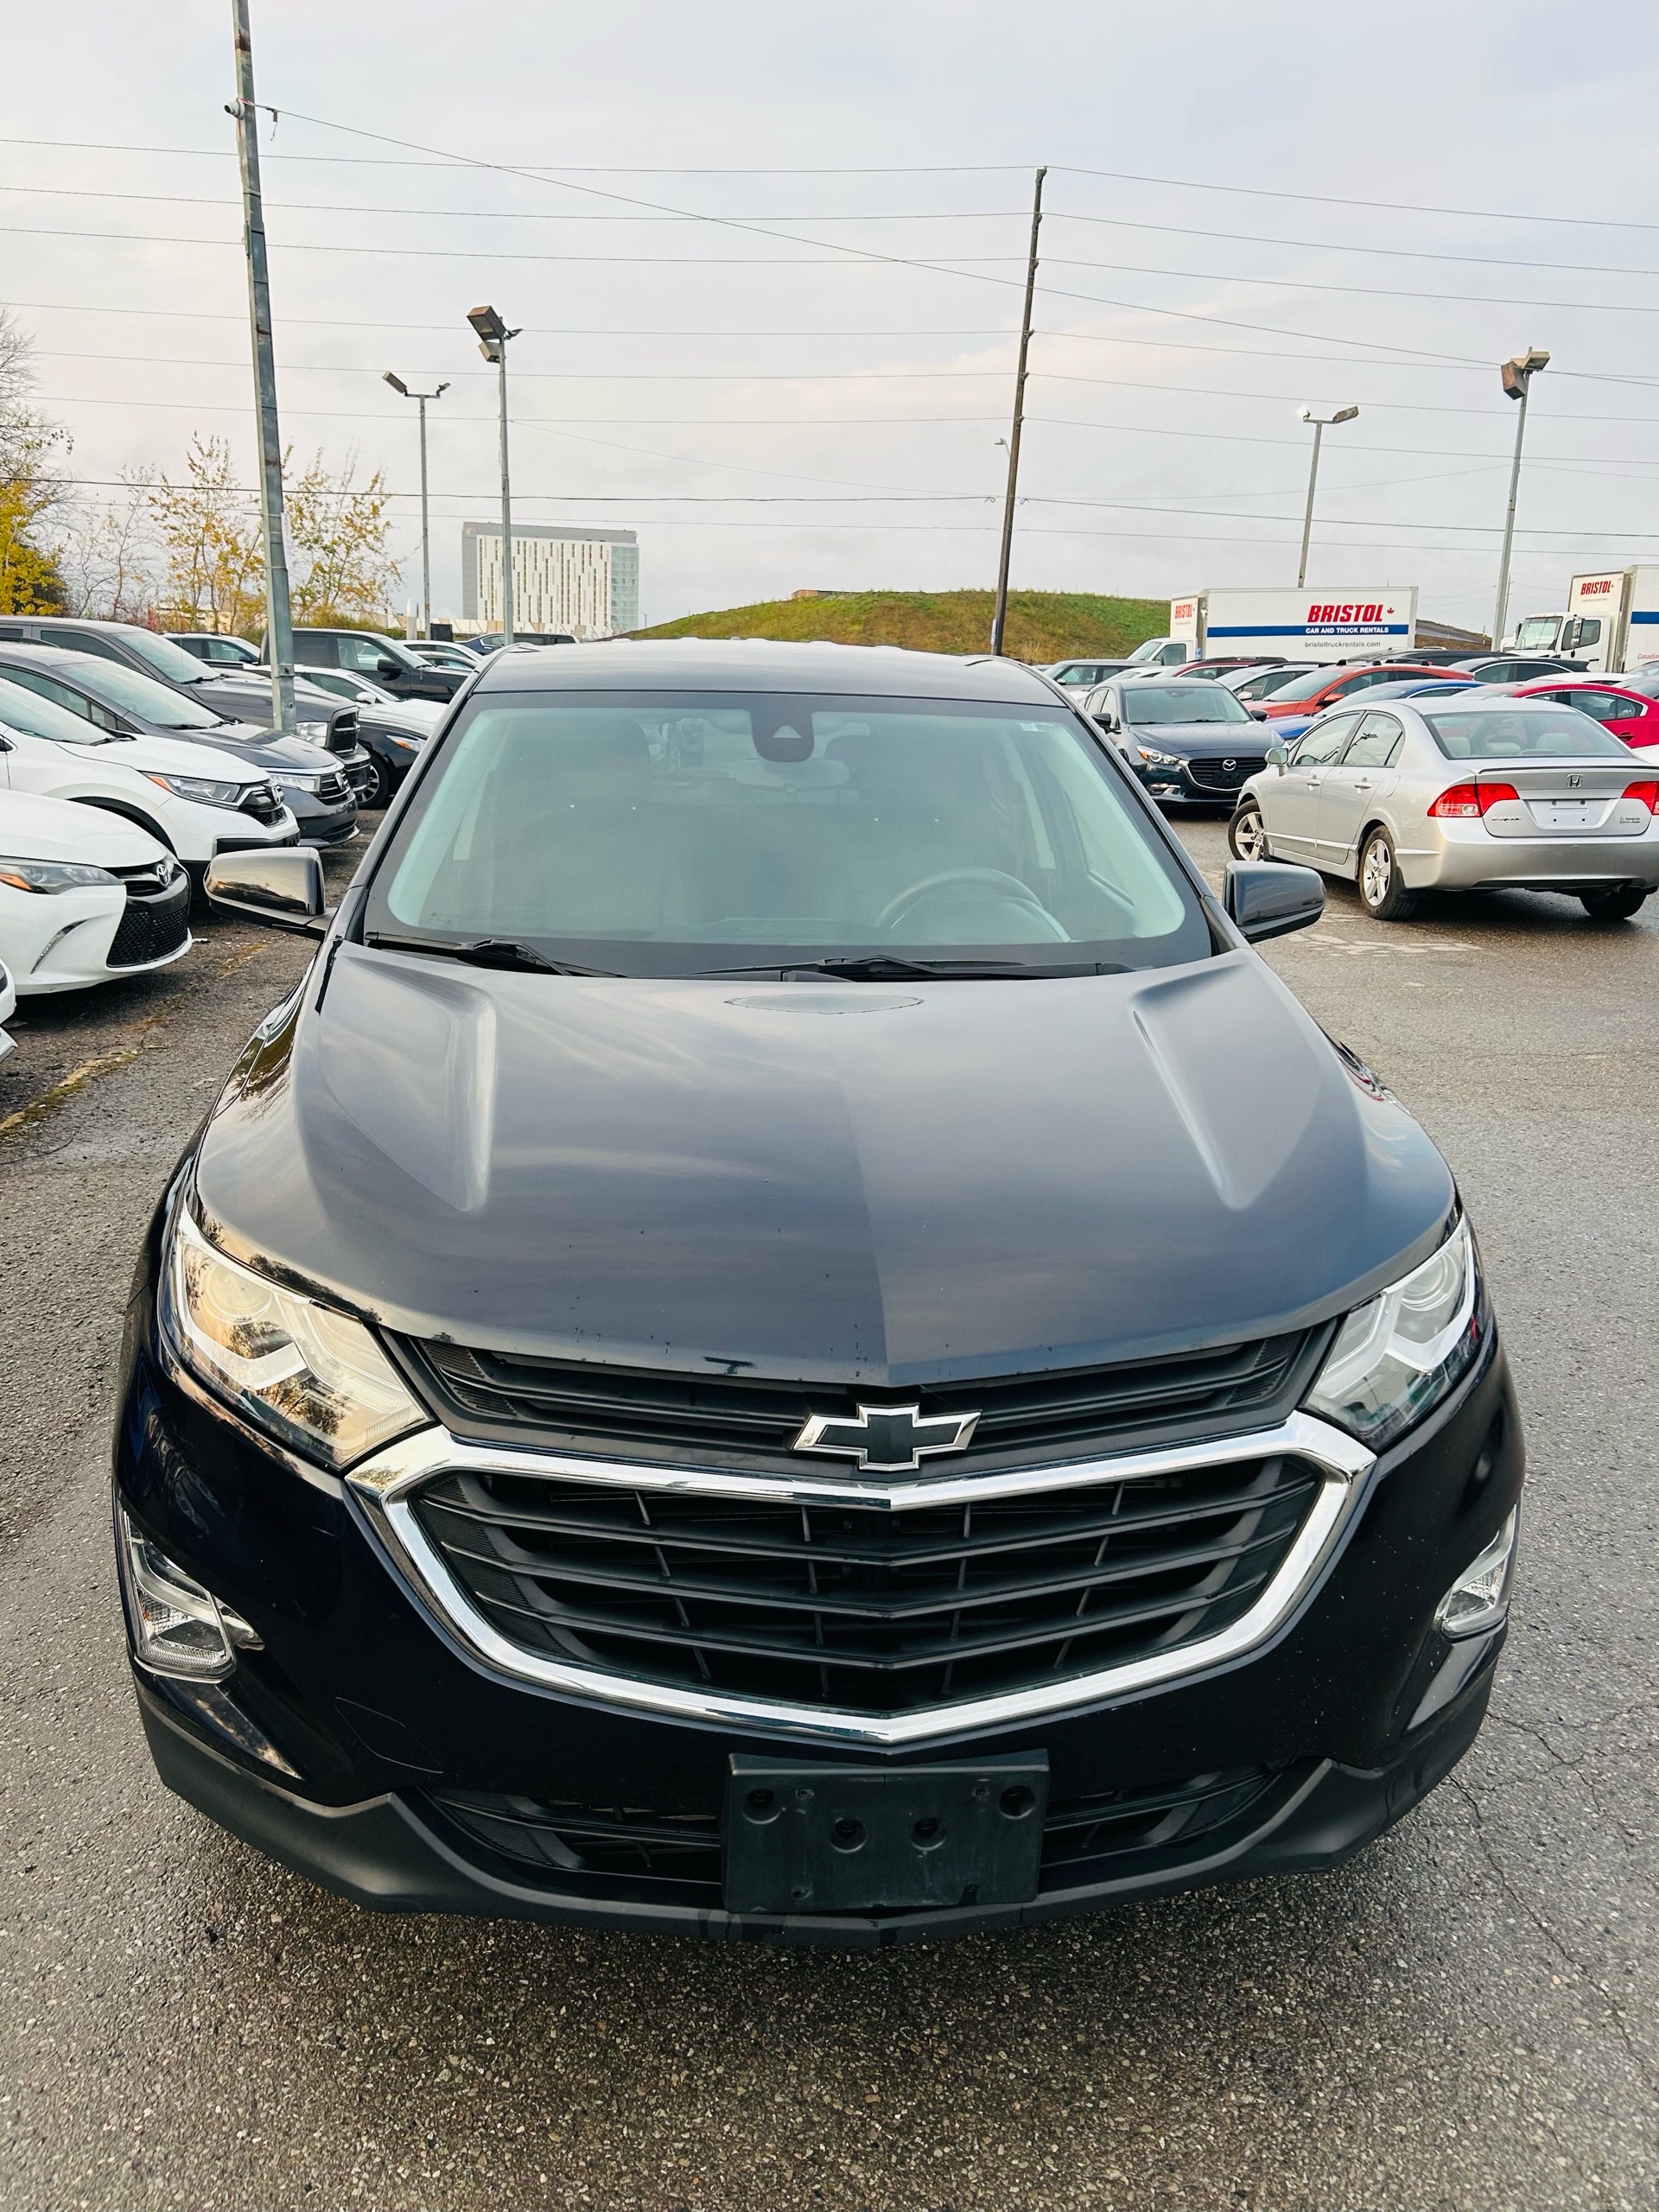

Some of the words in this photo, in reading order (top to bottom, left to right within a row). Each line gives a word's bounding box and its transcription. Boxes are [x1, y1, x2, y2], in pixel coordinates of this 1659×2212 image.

[1580, 581, 1611, 595] BRISTOL
[1175, 604, 1192, 619] BRISTOL
[1307, 605, 1383, 622] BRISTOL
